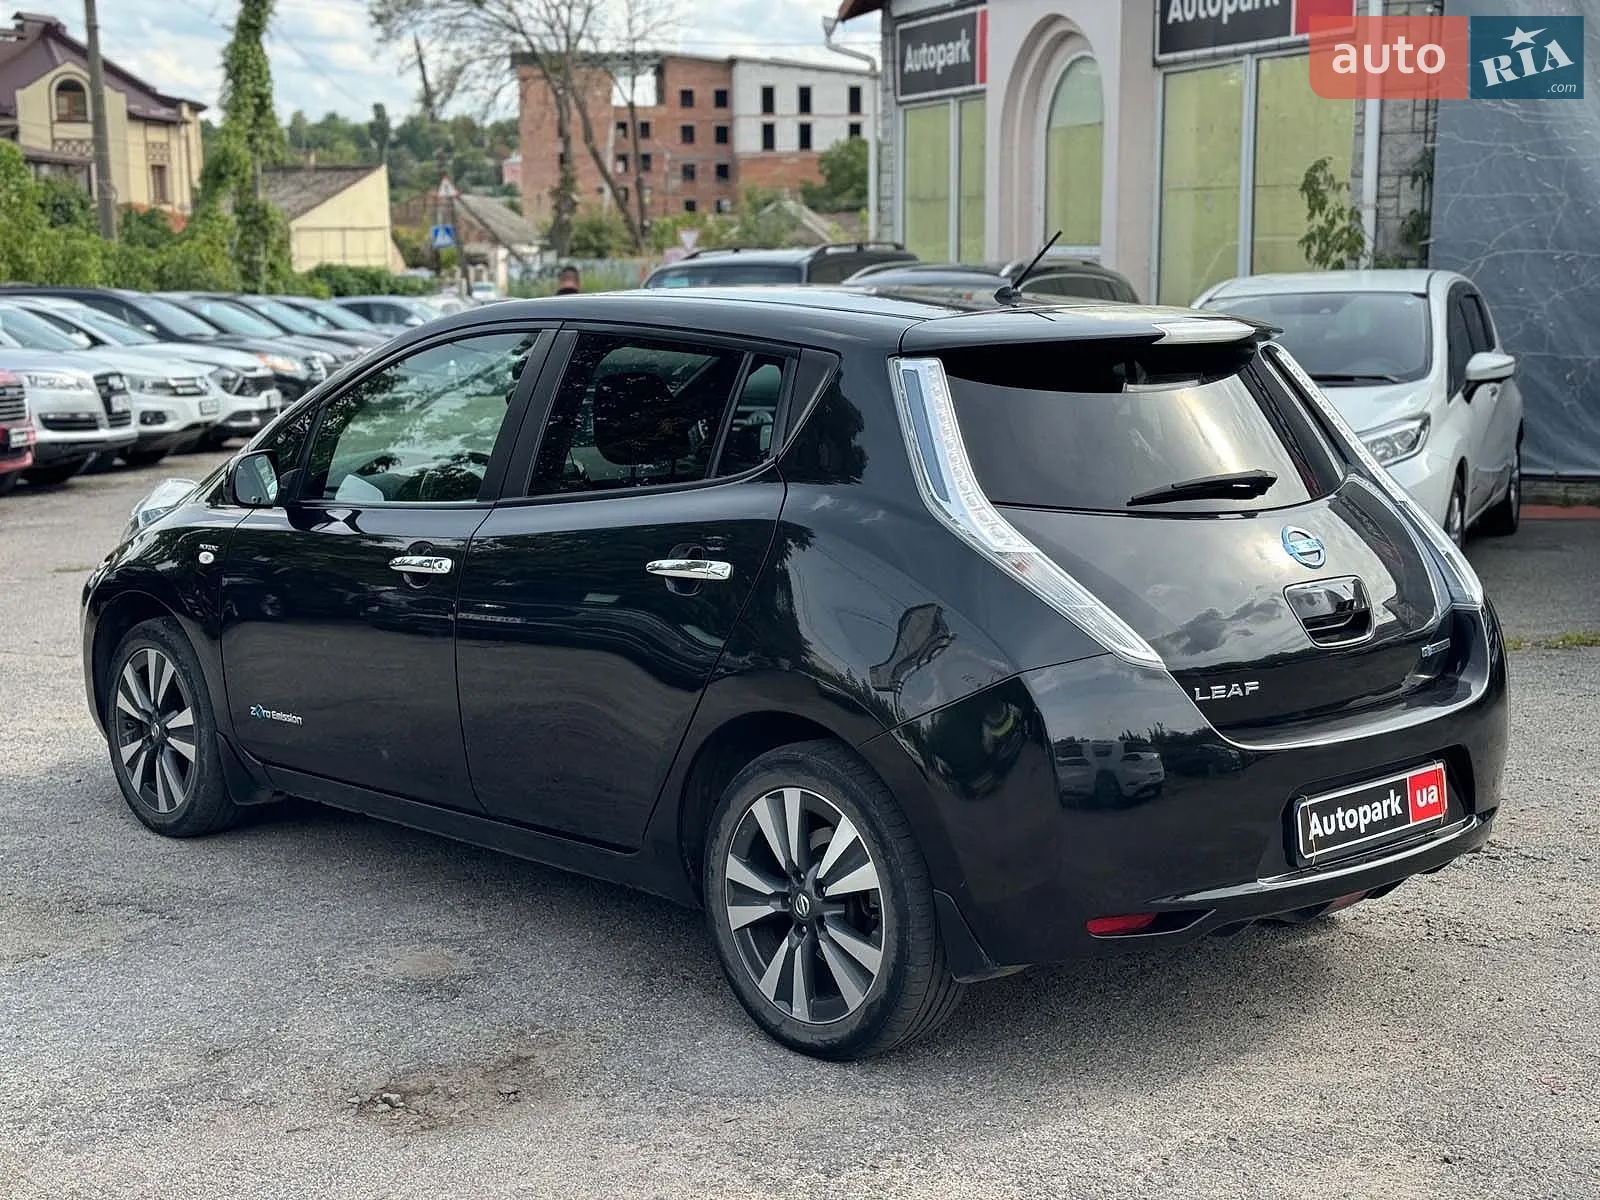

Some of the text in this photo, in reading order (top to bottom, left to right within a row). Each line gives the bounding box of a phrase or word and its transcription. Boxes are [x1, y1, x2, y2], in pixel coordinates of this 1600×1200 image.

[904, 28, 970, 74] Autopark
[1194, 681, 1260, 701] LEAF
[1309, 785, 1438, 841] Autopark ua
